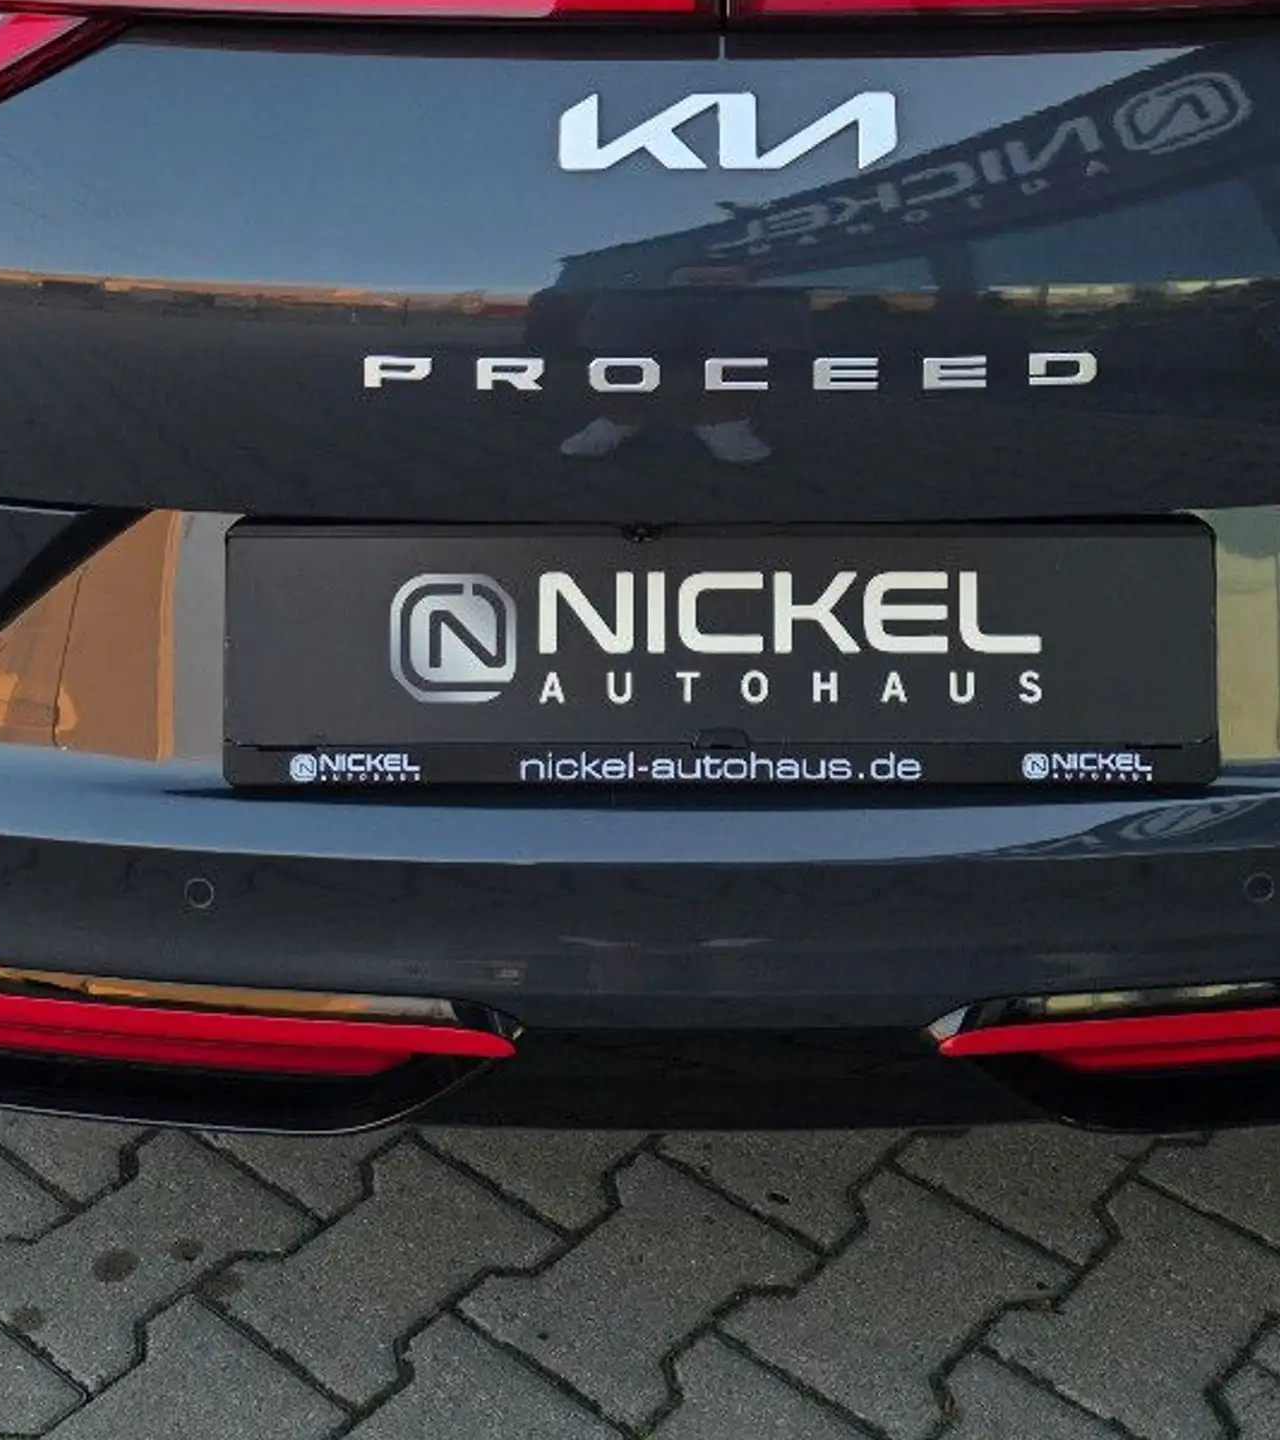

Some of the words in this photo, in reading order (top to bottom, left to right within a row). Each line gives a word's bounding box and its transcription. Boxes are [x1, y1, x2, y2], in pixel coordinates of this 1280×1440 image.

[558, 90, 898, 172] KIA
[363, 351, 1098, 393] PROCEED
[537, 570, 1043, 655] NICKEL
[538, 670, 1043, 705] AUTOHAUS
[319, 753, 420, 772] NICKEL
[519, 751, 923, 781] nickel-autohaus.de
[1051, 752, 1153, 772] NICKEL
